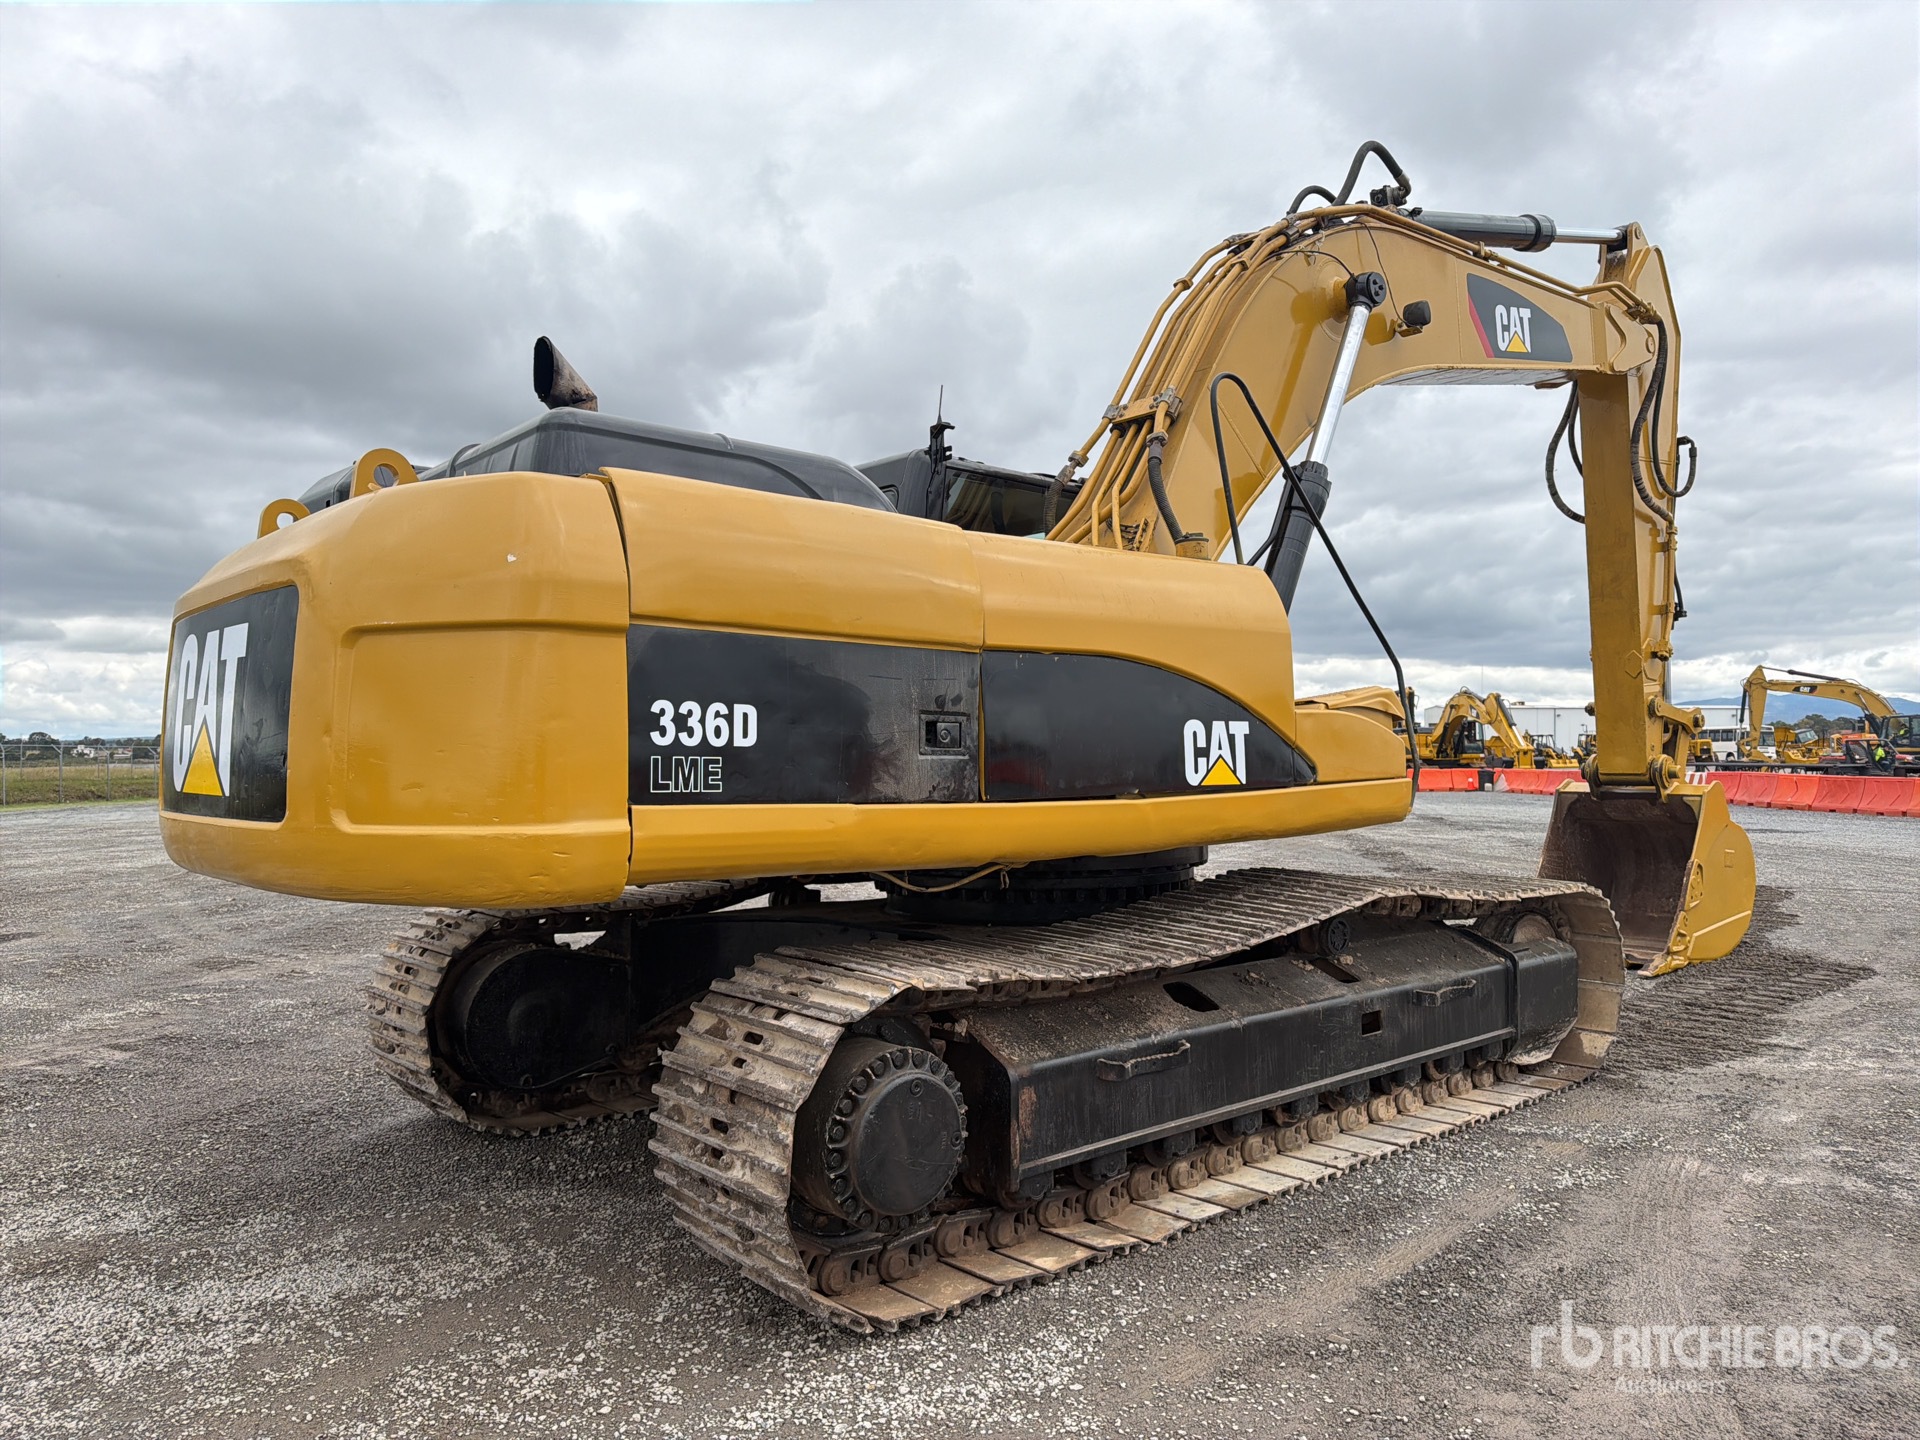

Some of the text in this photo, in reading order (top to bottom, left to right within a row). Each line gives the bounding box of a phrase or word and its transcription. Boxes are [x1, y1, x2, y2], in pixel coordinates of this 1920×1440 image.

[1495, 304, 1532, 353] CAT
[173, 622, 249, 797] CAT
[650, 699, 758, 747] 336D
[650, 756, 723, 793] LME
[1183, 719, 1250, 787] CAT
